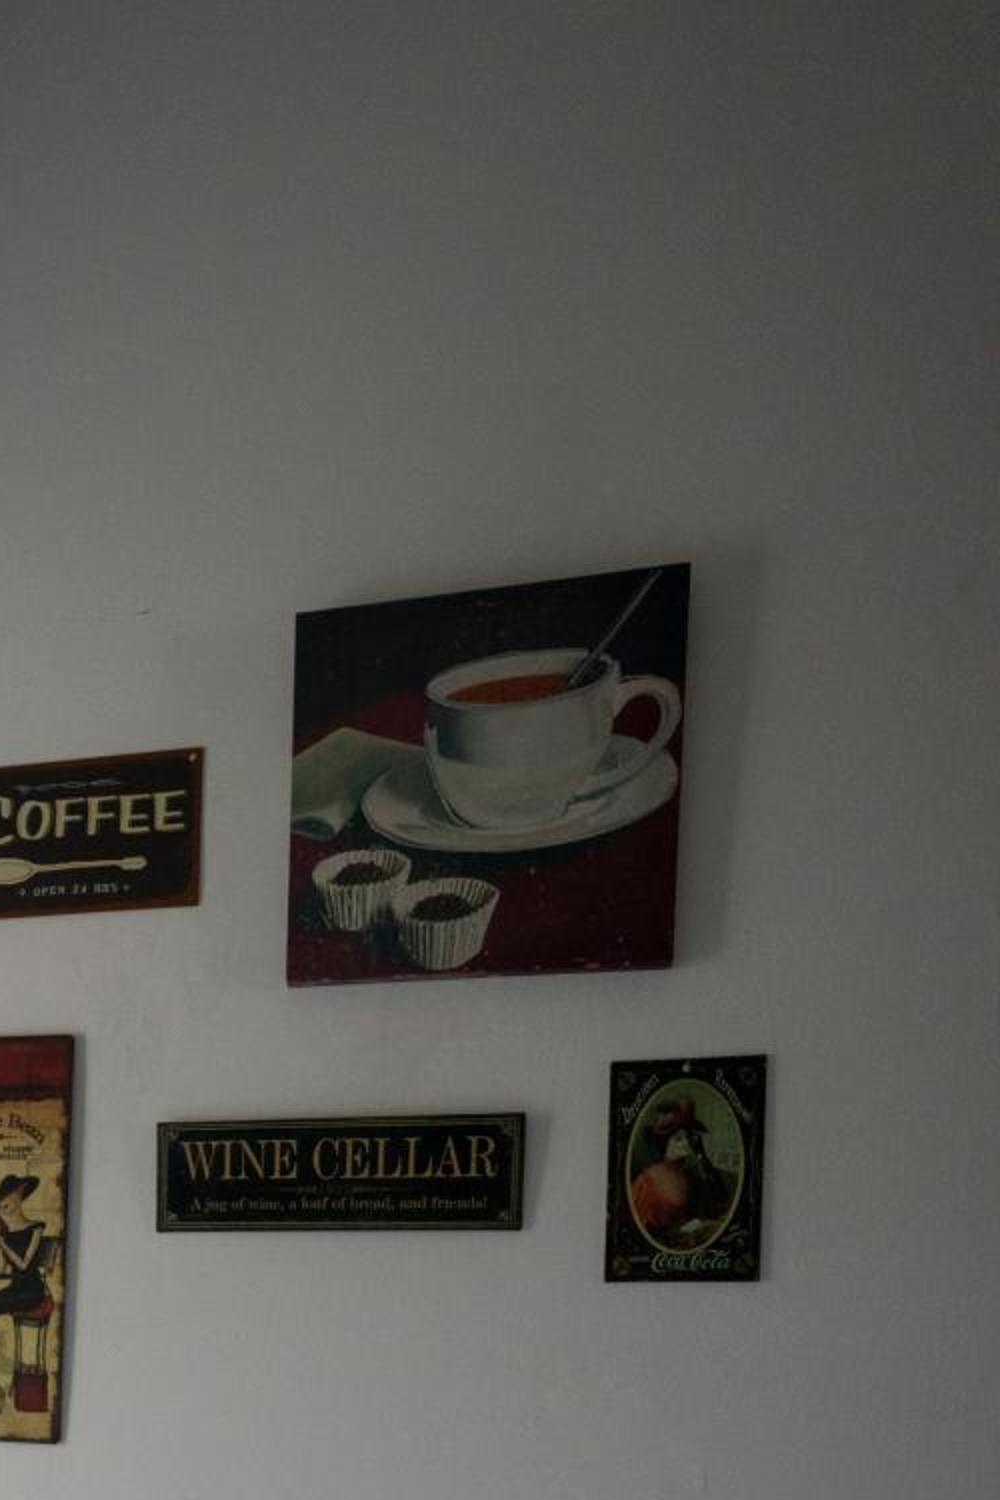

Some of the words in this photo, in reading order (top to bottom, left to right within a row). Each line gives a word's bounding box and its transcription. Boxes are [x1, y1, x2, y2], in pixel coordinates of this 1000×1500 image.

[33, 885, 65, 896] OPEN
[182, 1139, 298, 1182] WINE
[312, 1135, 499, 1181] CELLAR
